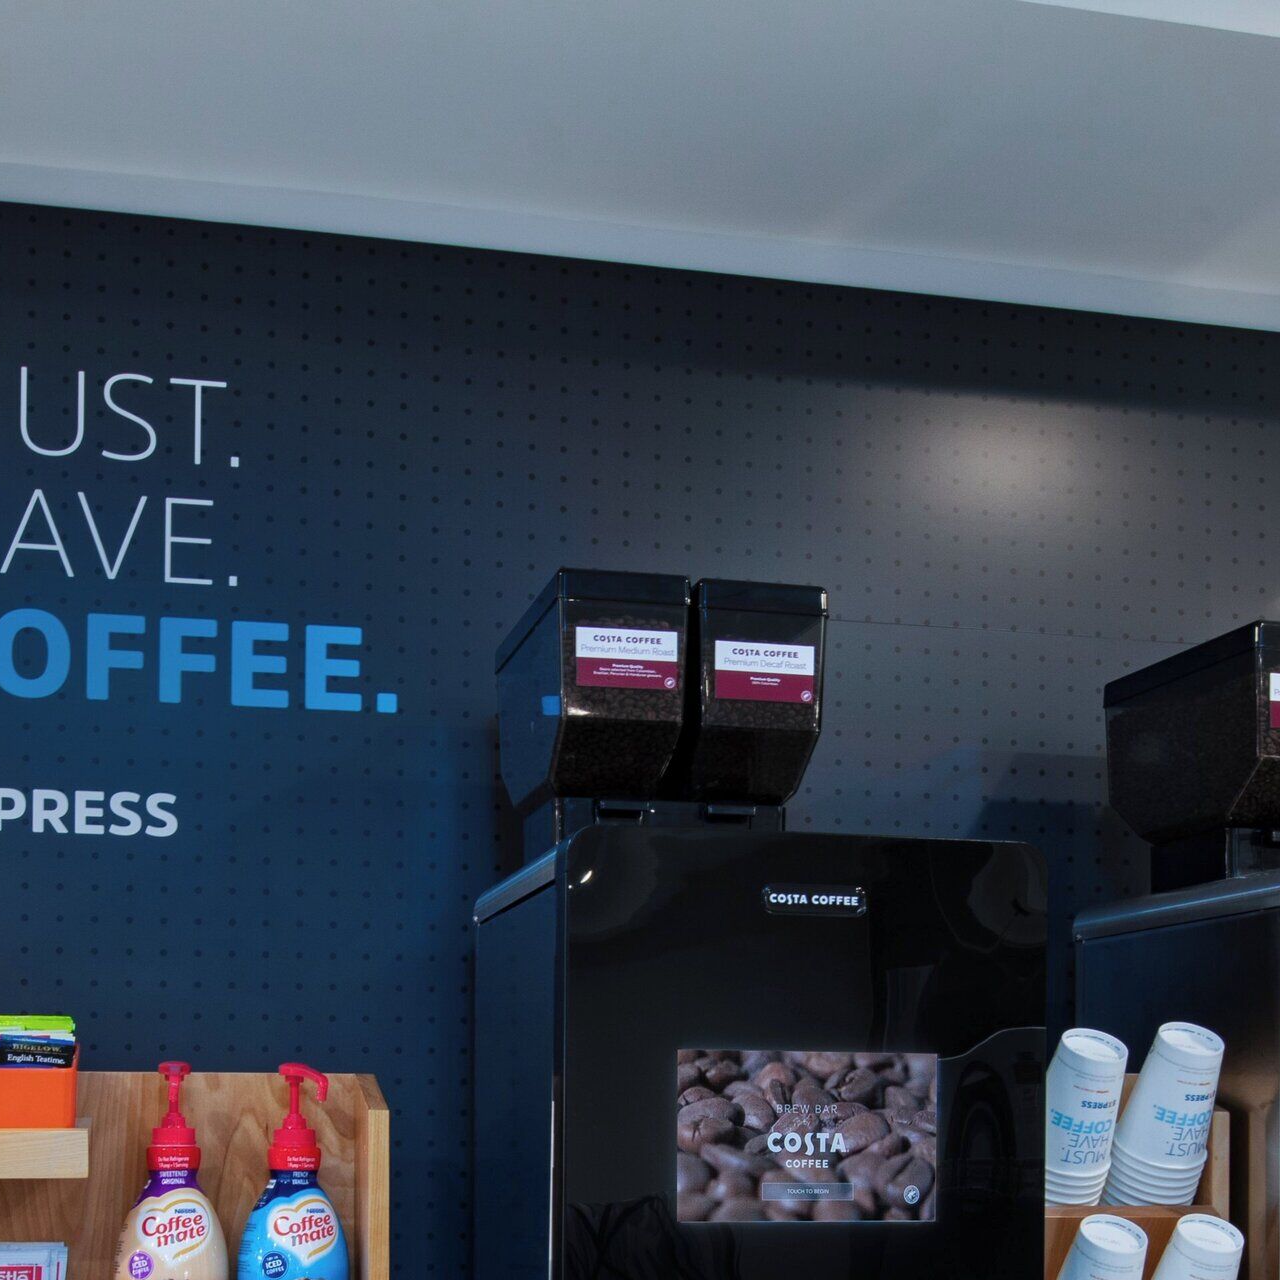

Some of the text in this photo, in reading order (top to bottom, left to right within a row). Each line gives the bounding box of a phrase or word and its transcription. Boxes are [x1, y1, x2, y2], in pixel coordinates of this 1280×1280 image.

[593, 634, 662, 645] COSTA COFFEE
[581, 643, 674, 657] Premium Medium Roast
[732, 648, 799, 658] COSTA COFFEE
[724, 657, 807, 670] Premium Decaf Roast
[769, 893, 859, 906] COSTA COFFEE
[7, 1053, 34, 1063] English
[776, 1104, 838, 1114] BREW BAR
[1051, 1108, 1113, 1135] COFFEE.
[767, 1132, 847, 1156] COSTA
[1066, 1132, 1109, 1149] HAVE.
[1060, 1146, 1106, 1165] MUST.
[785, 1159, 829, 1169] COFFEE
[142, 1214, 203, 1237] Coffee
[273, 1214, 331, 1236] Coffee
[157, 1225, 205, 1247] mate
[291, 1225, 334, 1246] mate
[132, 1260, 148, 1270] ICED
[265, 1260, 282, 1269] ICED
[266, 1266, 285, 1275] COFFEE
